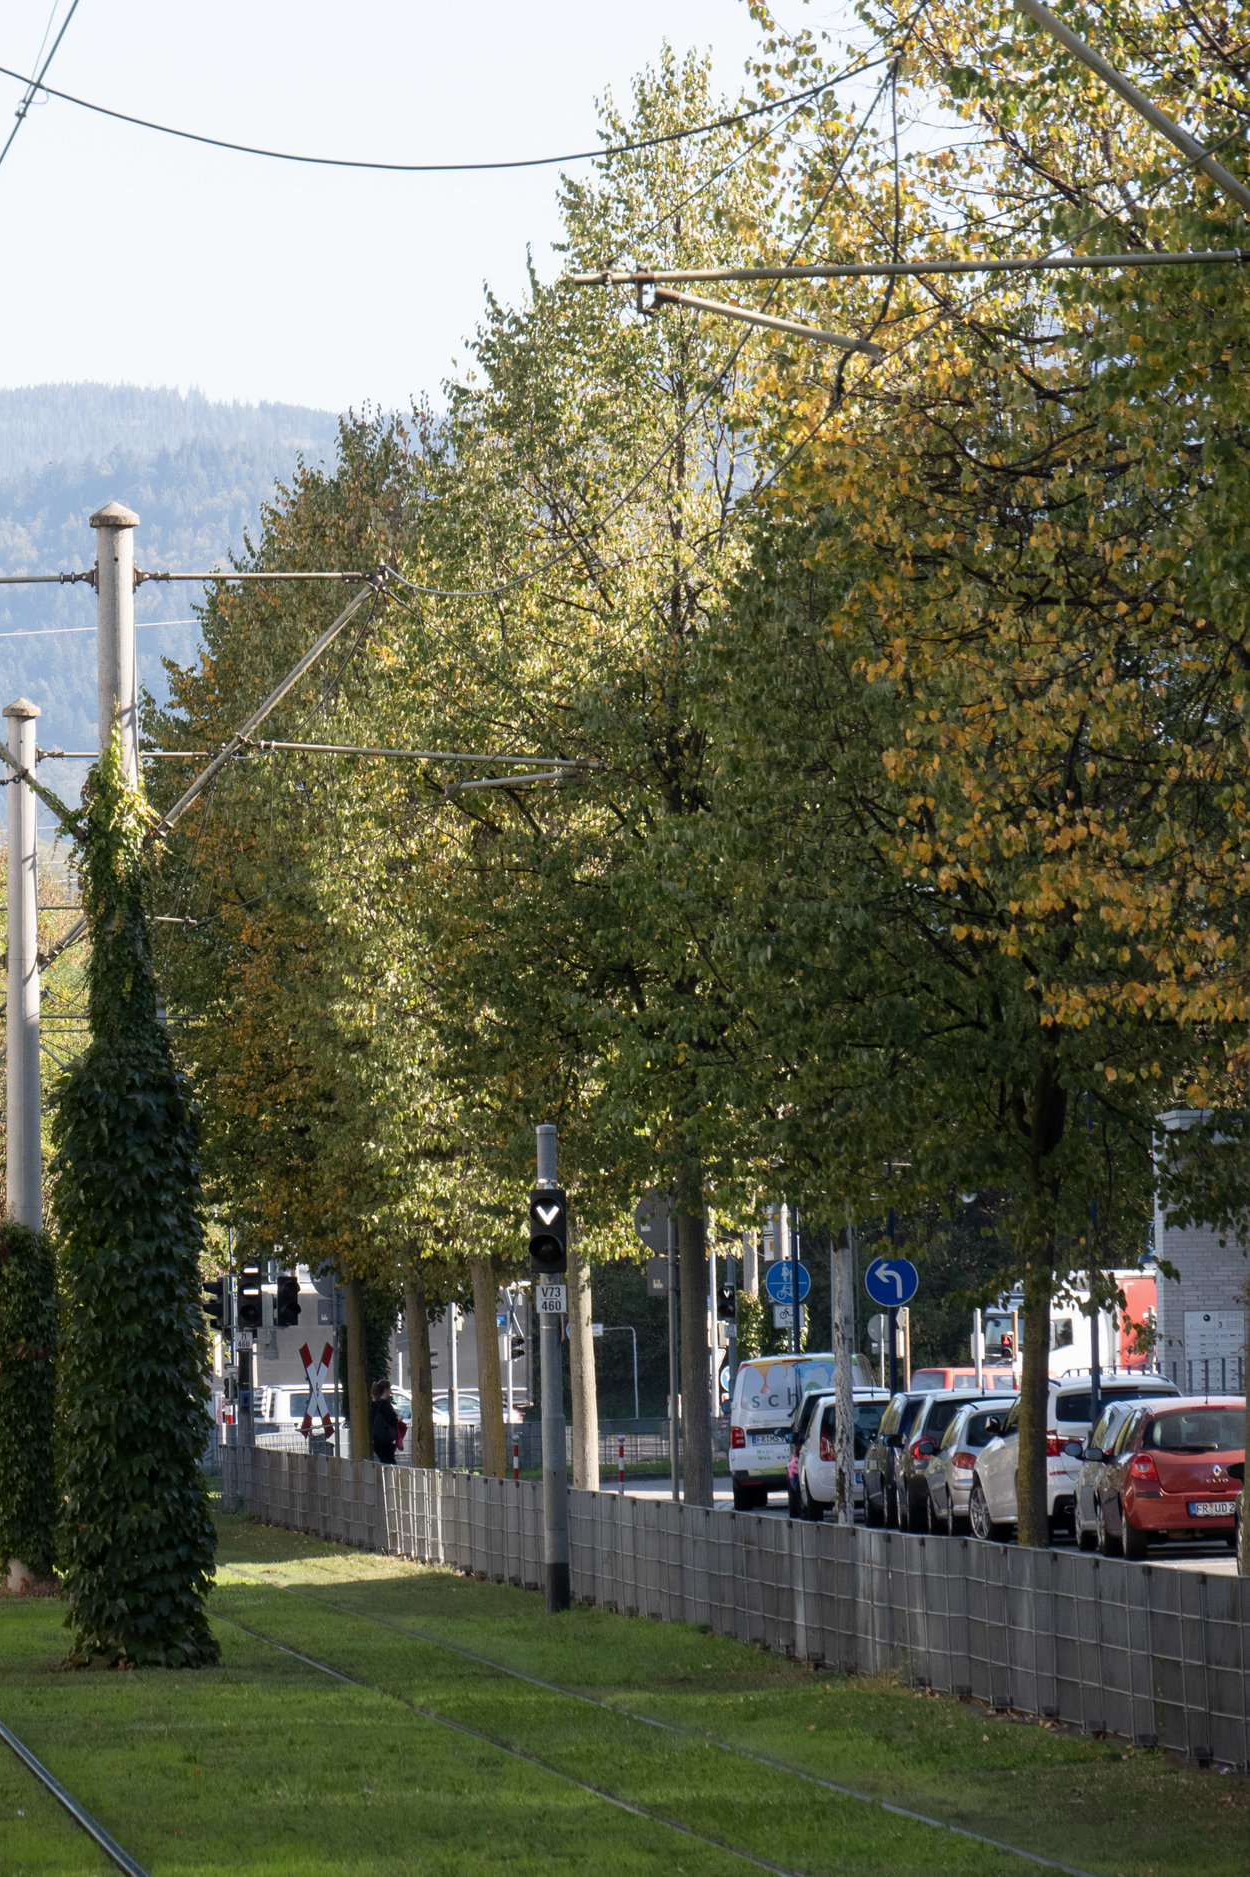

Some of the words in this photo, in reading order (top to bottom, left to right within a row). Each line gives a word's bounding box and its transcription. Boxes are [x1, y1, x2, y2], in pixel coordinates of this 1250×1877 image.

[541, 1286, 561, 1297] V73
[541, 1300, 562, 1311] 460
[1217, 1321, 1223, 1329] 3
[1196, 1504, 1209, 1513] FR
[1214, 1503, 1228, 1513] UD
